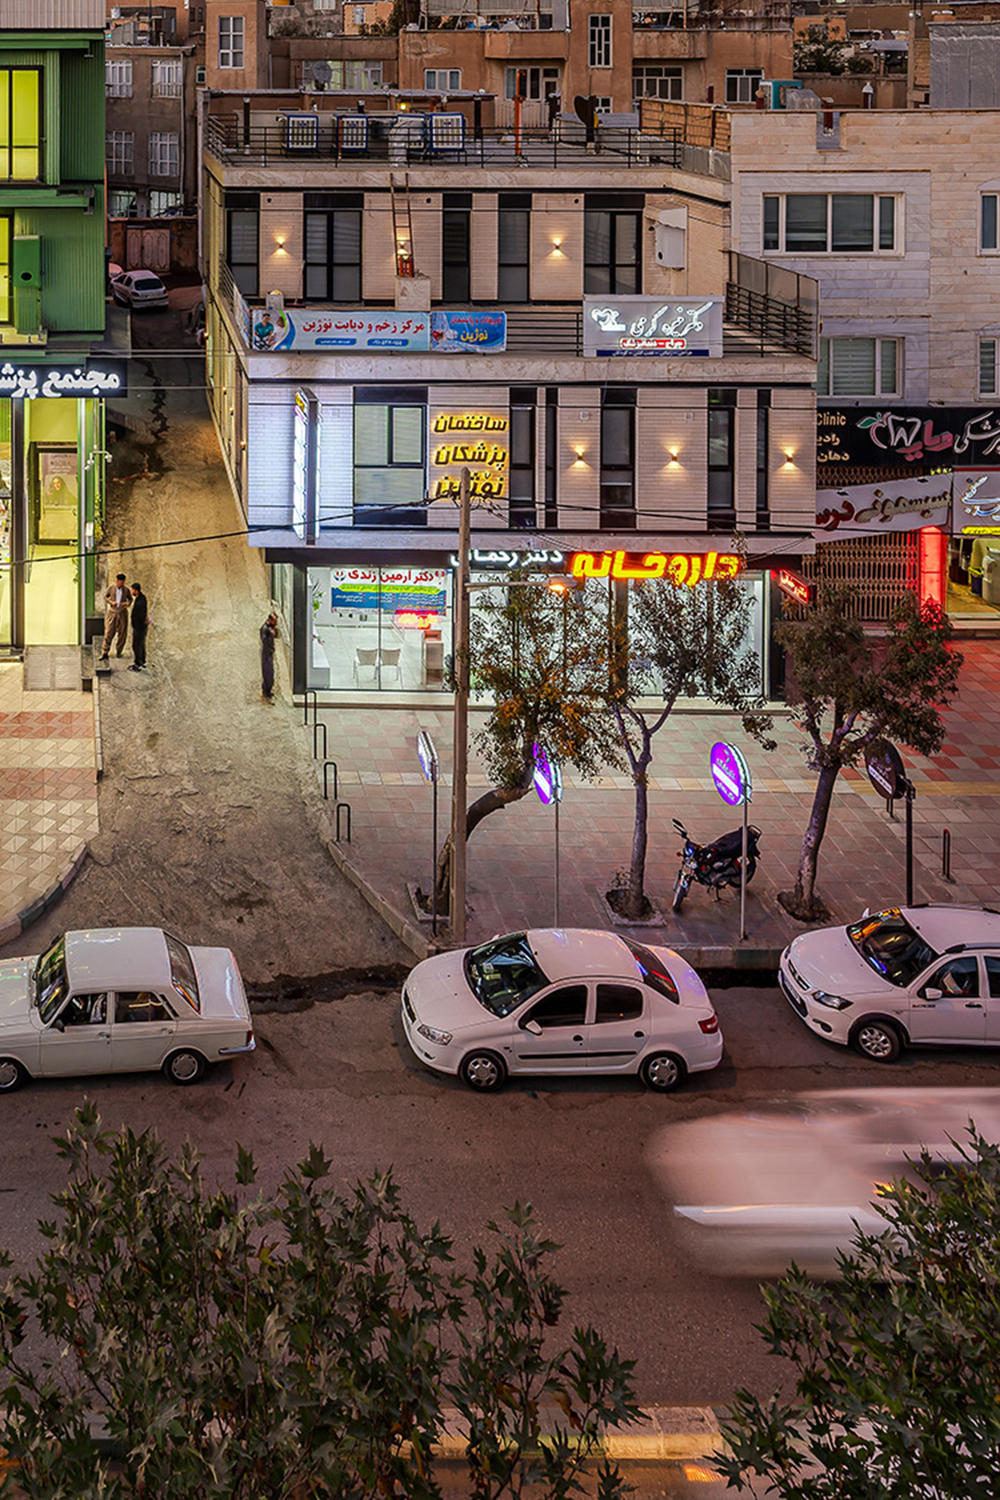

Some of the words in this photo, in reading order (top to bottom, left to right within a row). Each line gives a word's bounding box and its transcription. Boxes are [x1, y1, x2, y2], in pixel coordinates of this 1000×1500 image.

[334, 318, 364, 333] دیابت
[366, 321, 373, 333] و
[375, 319, 397, 334] زخم
[399, 319, 425, 334] مرکز
[42, 367, 120, 396] مجتمع
[434, 414, 507, 433] ساختمان
[434, 442, 507, 471] پزشکان
[521, 549, 563, 567] دکتر
[348, 569, 377, 583] زندی
[571, 550, 740, 587] داروخانه
[413, 570, 435, 585] دکتر
